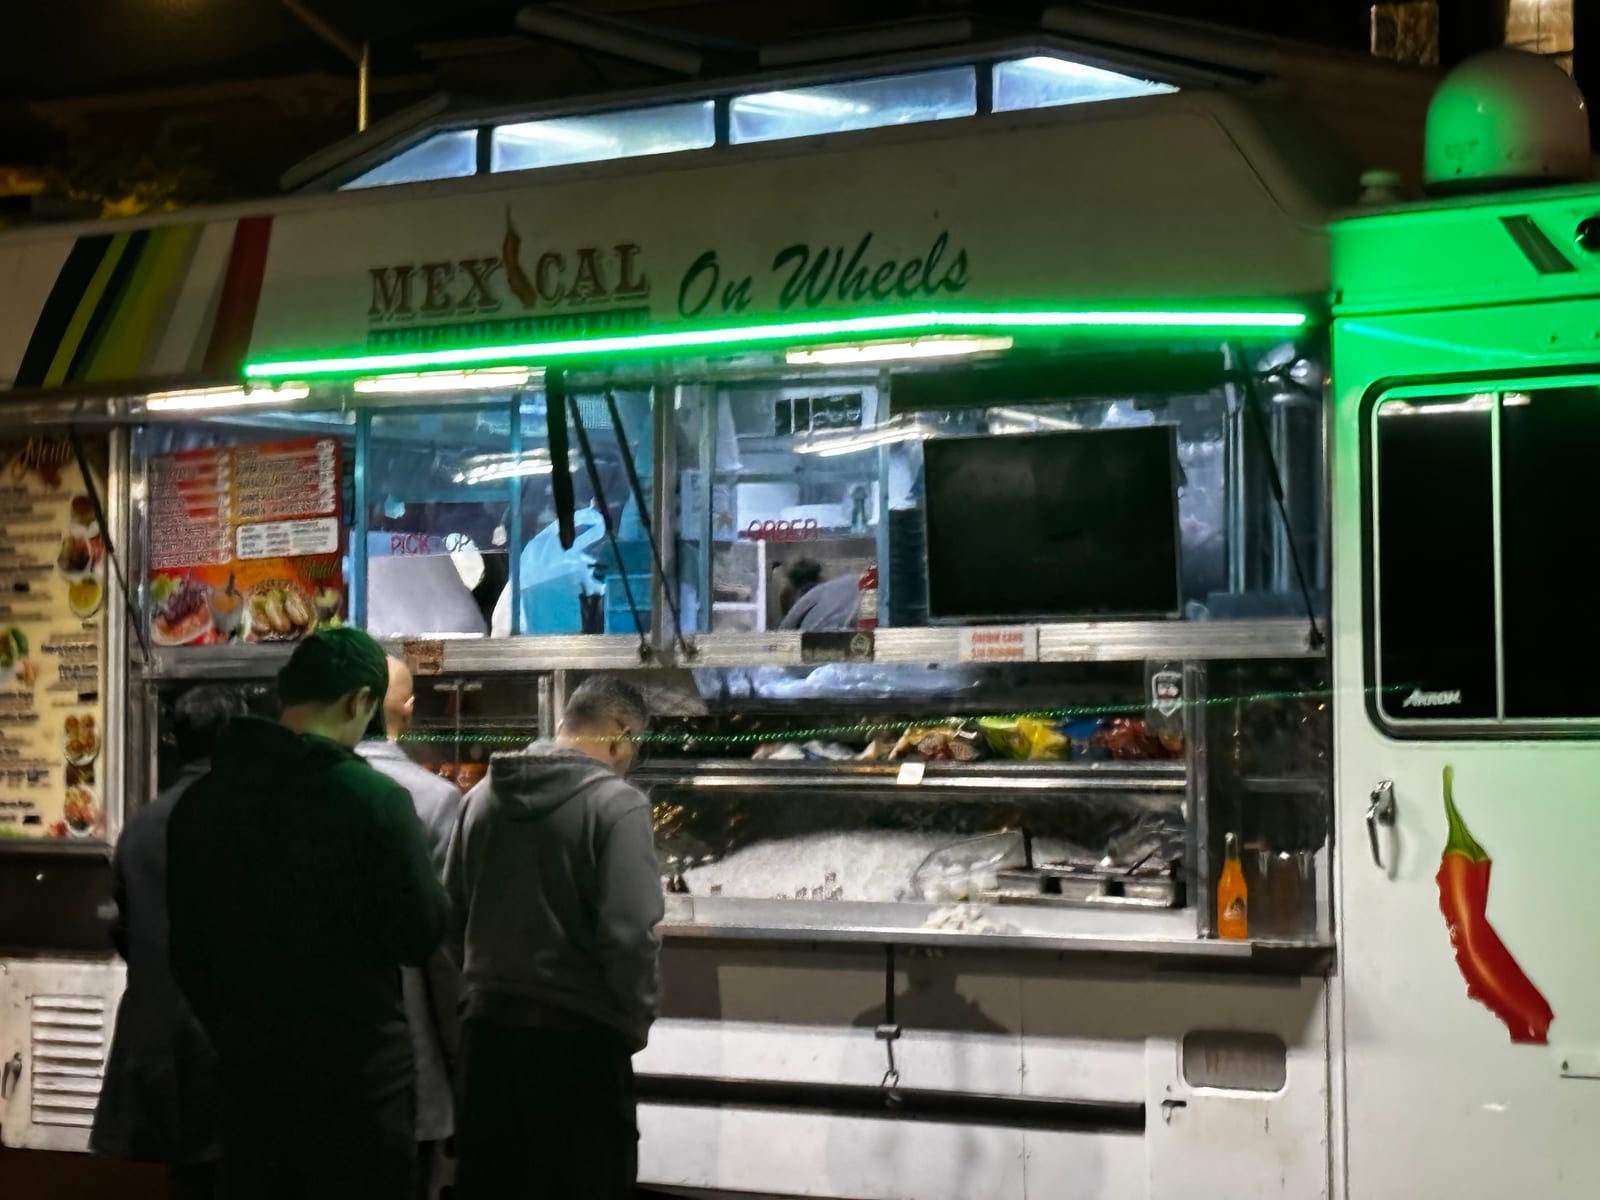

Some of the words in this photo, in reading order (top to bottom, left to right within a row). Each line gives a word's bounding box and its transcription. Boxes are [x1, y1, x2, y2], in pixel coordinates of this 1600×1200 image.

[677, 250, 753, 318] On
[772, 231, 969, 310] Wheels
[391, 533, 429, 554] PICK
